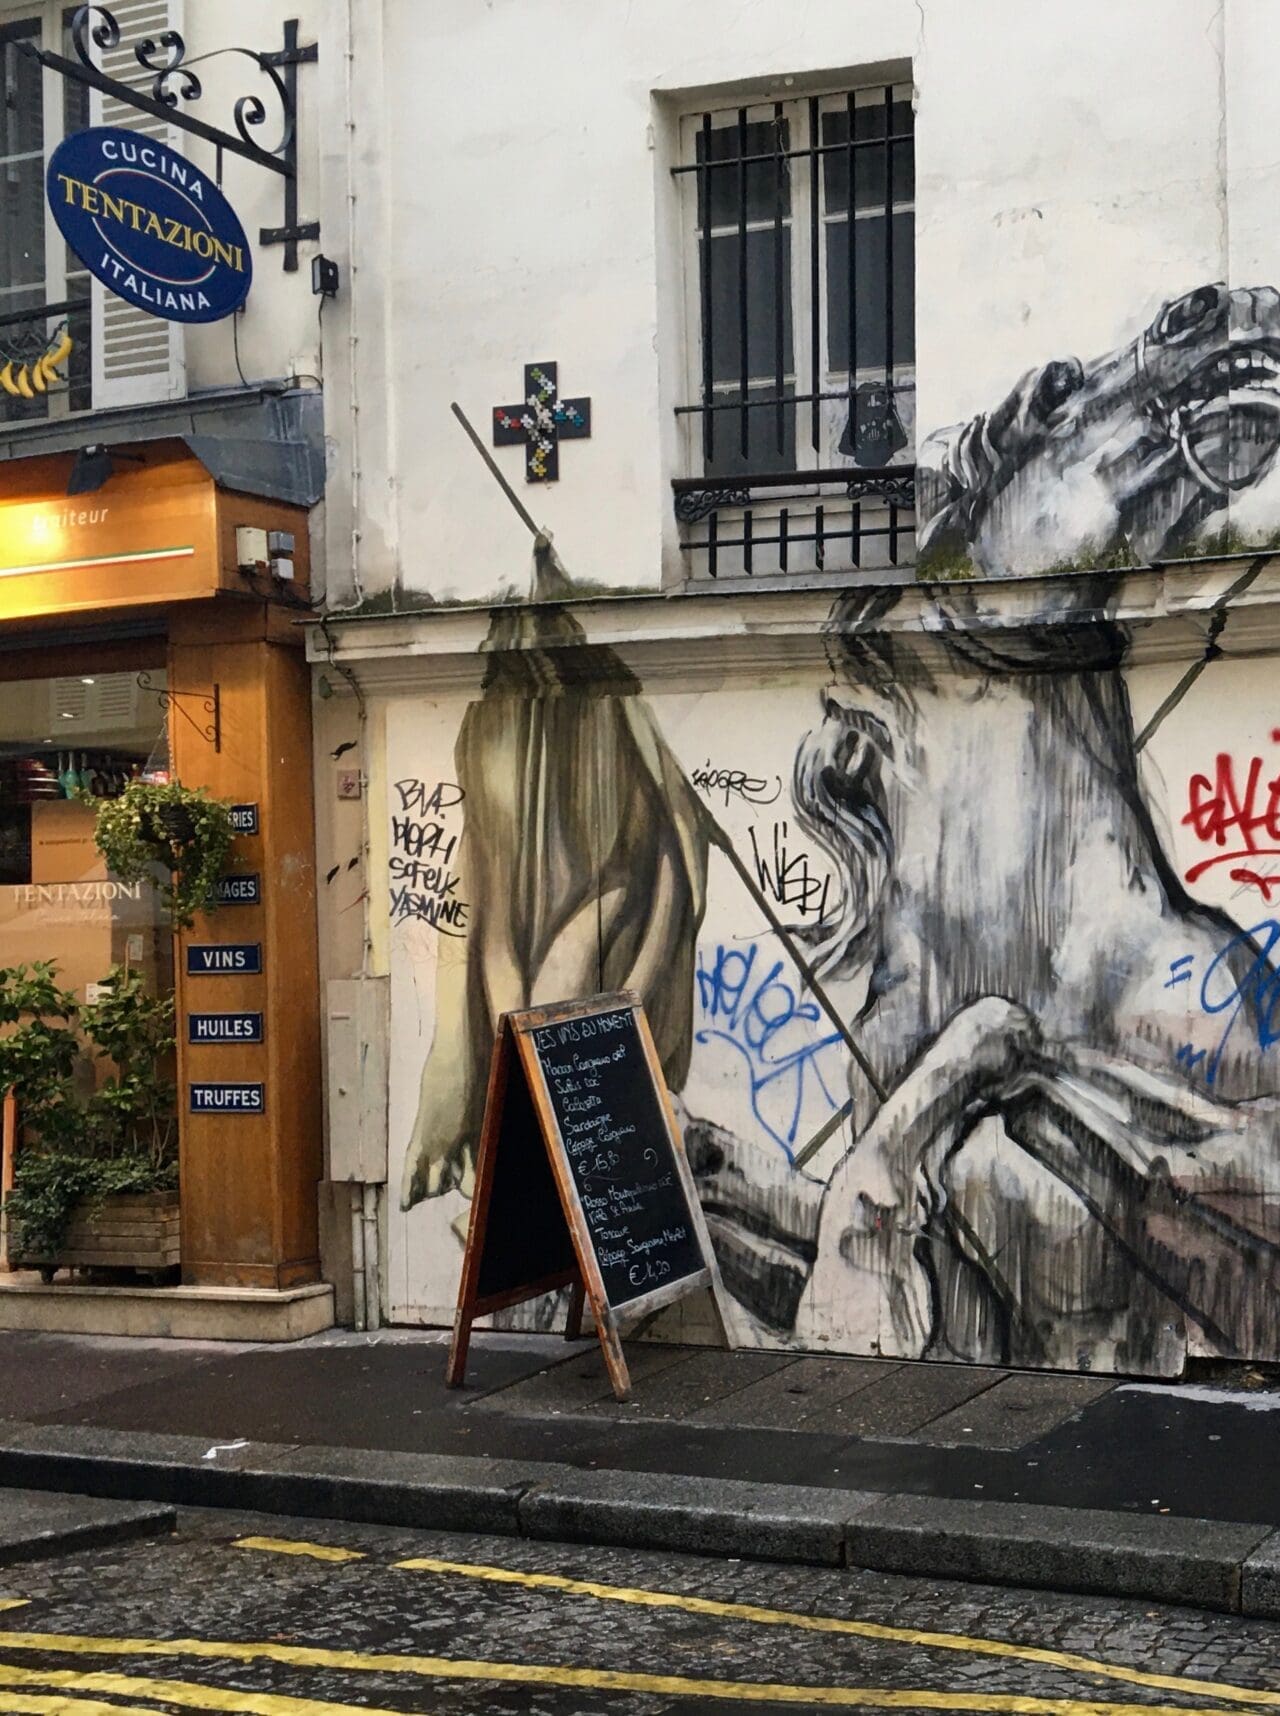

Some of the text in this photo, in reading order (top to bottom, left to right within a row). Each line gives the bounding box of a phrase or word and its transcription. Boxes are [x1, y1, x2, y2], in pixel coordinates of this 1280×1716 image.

[101, 140, 203, 201] CUCINA
[57, 174, 244, 273] TENTAZIONI
[101, 253, 211, 312] ITALIANA
[202, 951, 246, 968] VINS
[197, 1019, 254, 1037] HUILES
[194, 1089, 260, 1106] TRUFFES
